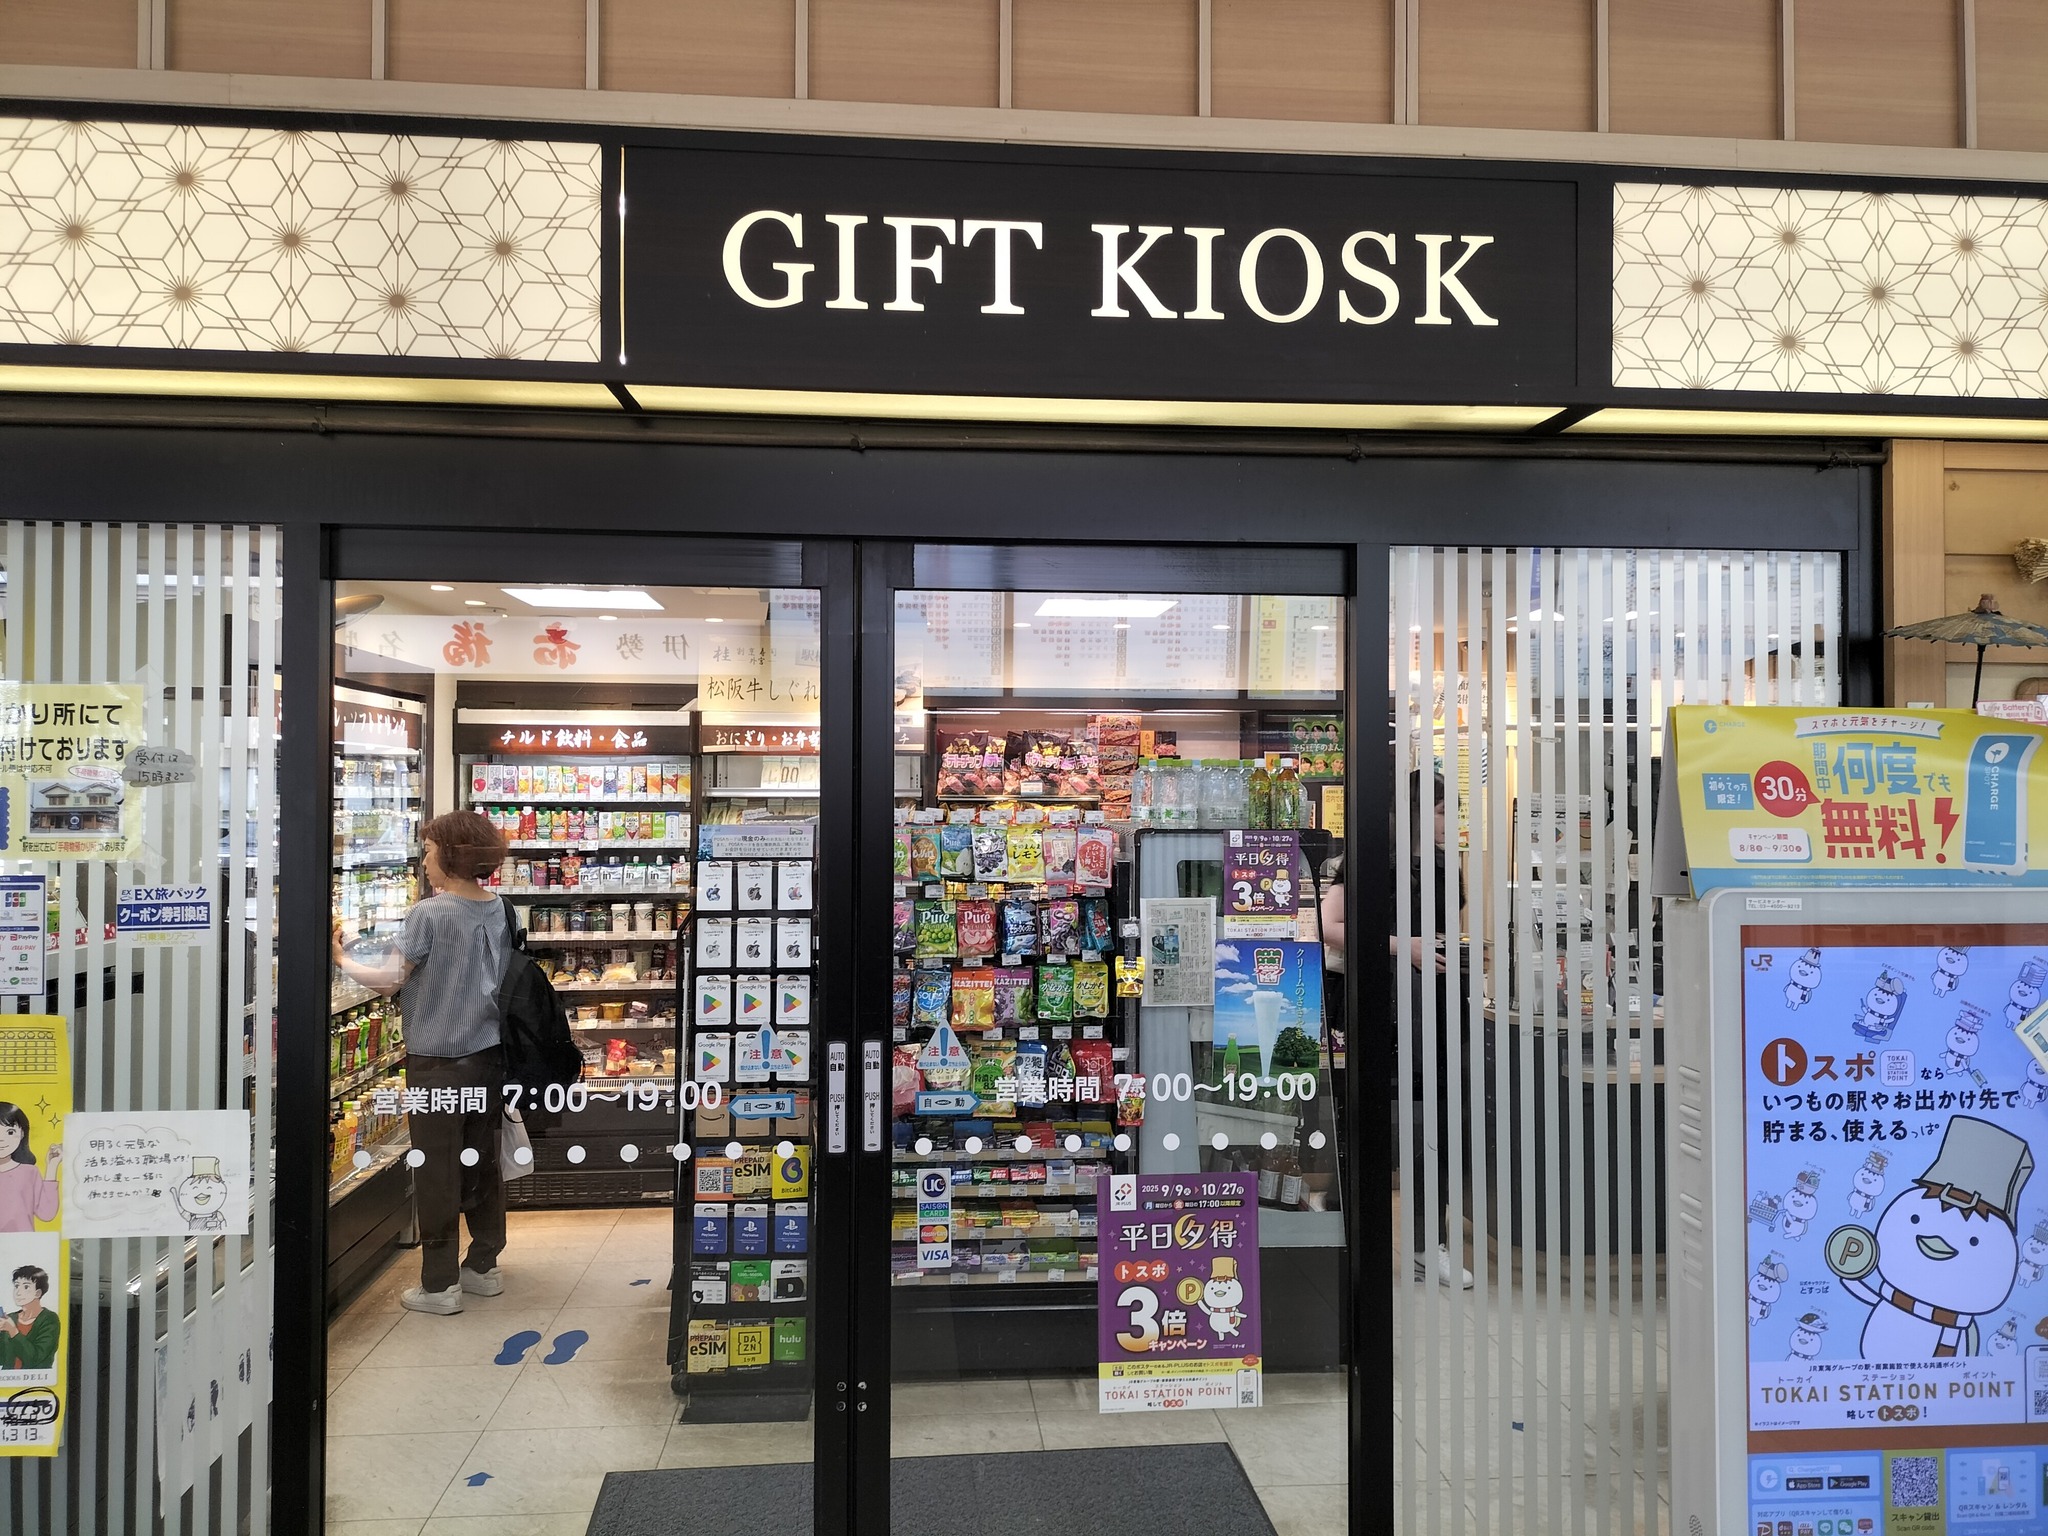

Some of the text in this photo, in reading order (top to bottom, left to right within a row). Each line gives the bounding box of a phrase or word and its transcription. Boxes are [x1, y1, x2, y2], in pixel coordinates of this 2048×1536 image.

[722, 209, 1498, 327] GIFT KIOSK
[1812, 716, 1926, 731] スマホと元気をチャージ!
[500, 728, 648, 748] チルド飲料・食品
[135, 751, 179, 765] 受付は
[1813, 742, 1831, 794] 期間中
[1832, 741, 1951, 796] 何度でも
[138, 771, 185, 784] 15時まで
[1709, 780, 1748, 792] 初めての方
[1760, 775, 1807, 802] 30分
[1989, 765, 1999, 811] CHARGE
[1717, 793, 1741, 804] 限定!
[1013, 850, 1041, 860] レモン
[1091, 843, 1100, 868] おいしい
[1234, 853, 1289, 866] 平日夕得
[134, 886, 207, 901] EX旅パック
[120, 906, 208, 924] クーポン券引換店
[1751, 954, 1773, 967] JR
[1076, 981, 1105, 990] かむかむ
[830, 1052, 844, 1060] AUTO
[865, 1050, 879, 1059] AUTO
[830, 1064, 844, 1072] 自動
[865, 1062, 879, 1070] 自動
[1777, 1043, 1944, 1083] トスポ なら
[865, 1092, 879, 1101] PUSH
[994, 1076, 1100, 1103] 営業時間
[373, 1086, 487, 1115] 営業時間
[830, 1094, 844, 1102] PUSH
[1763, 1088, 2021, 1112] いつもの駅やお出かけ先で
[734, 1163, 771, 1177] eSIM
[1141, 1185, 1159, 1193] 2025
[920, 1202, 948, 1210] SAISON
[920, 1227, 947, 1238] MasterCard
[1119, 1219, 1238, 1251] 平日夕得
[922, 1250, 949, 1261] VISA
[1839, 1236, 1865, 1266] P
[1120, 1262, 1167, 1280] トスポ
[1185, 1283, 1197, 1300] P
[1800, 1285, 1830, 1294] とすっぱ
[1116, 1286, 1187, 1353] 3倍
[779, 1334, 801, 1343] hulu
[1148, 1338, 1208, 1352] キャンペーン
[690, 1341, 727, 1355] eSIM
[23, 1373, 49, 1381] DELI
[1778, 1370, 1997, 1384] トーカイ ステーション ポイント
[1105, 1386, 1232, 1400] TOKAI STATION POINT
[1761, 1380, 2015, 1404] TOKAI STATION POINT
[1891, 1512, 1940, 1523] スキャン貸出
